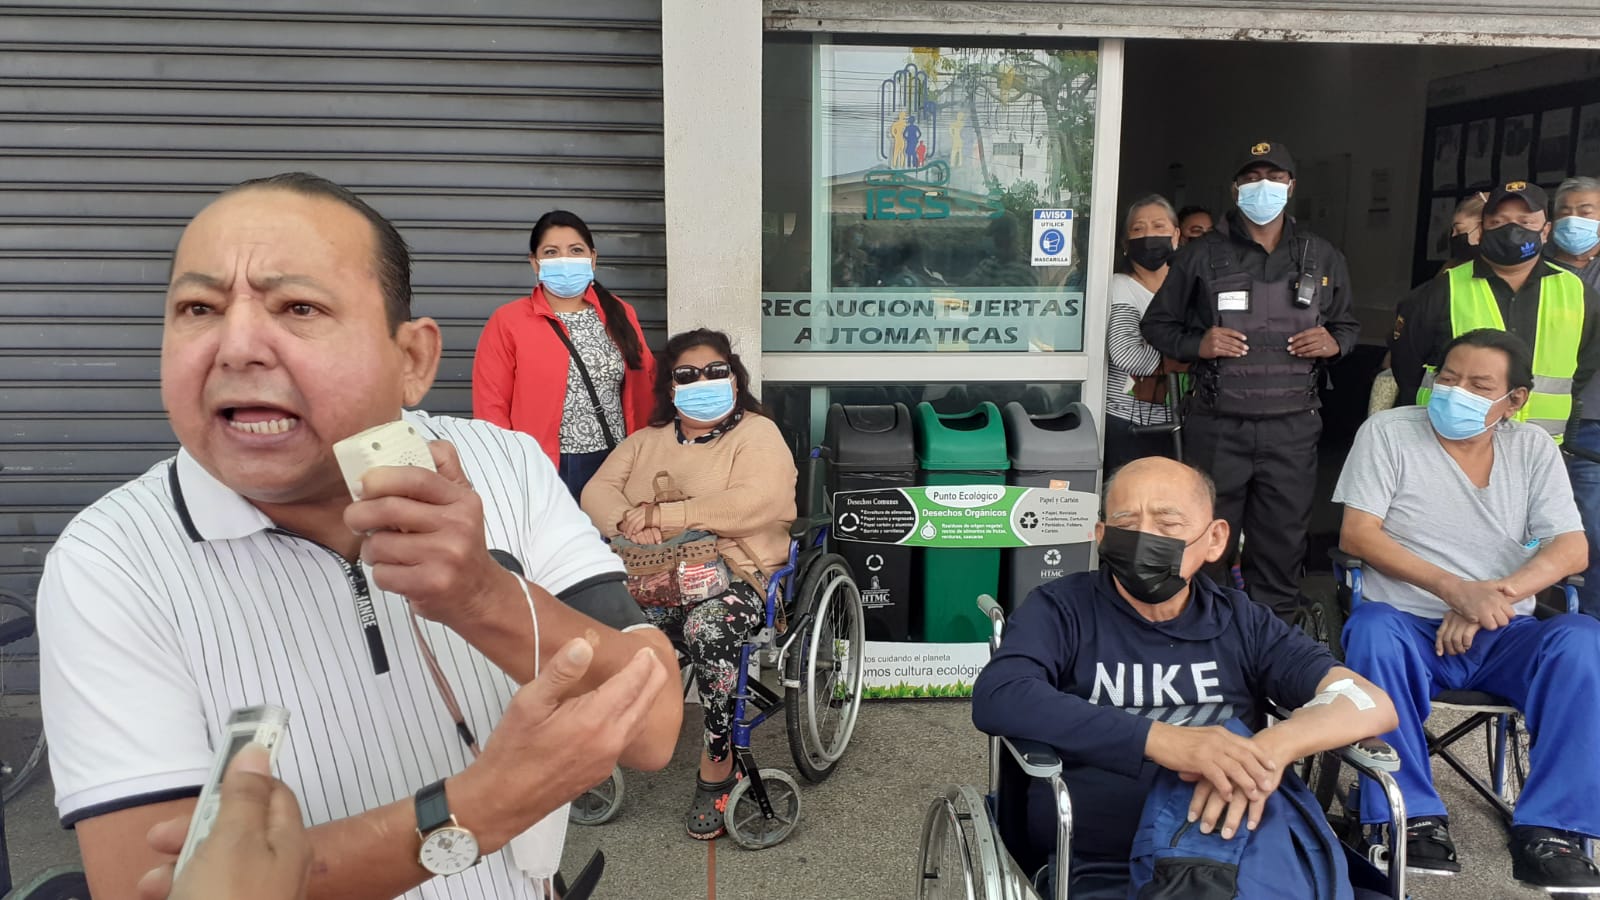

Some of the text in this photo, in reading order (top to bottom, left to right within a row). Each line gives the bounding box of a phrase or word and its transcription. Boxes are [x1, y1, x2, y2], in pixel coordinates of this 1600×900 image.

[866, 188, 950, 220] IESS
[1040, 211, 1067, 219] AVISO
[762, 299, 1079, 317] RECAUCION PUERTAS
[794, 326, 1018, 345] AUTOMATICAS
[933, 491, 998, 502] Punto Ecológico
[1039, 496, 1055, 505] Papel
[922, 508, 1007, 519] Desechos Orgánicos
[861, 594, 890, 602] HTMC
[878, 655, 912, 663] cuidando
[922, 654, 951, 664] planeta
[894, 665, 933, 677] cultura
[1088, 661, 1224, 707] NIKE
